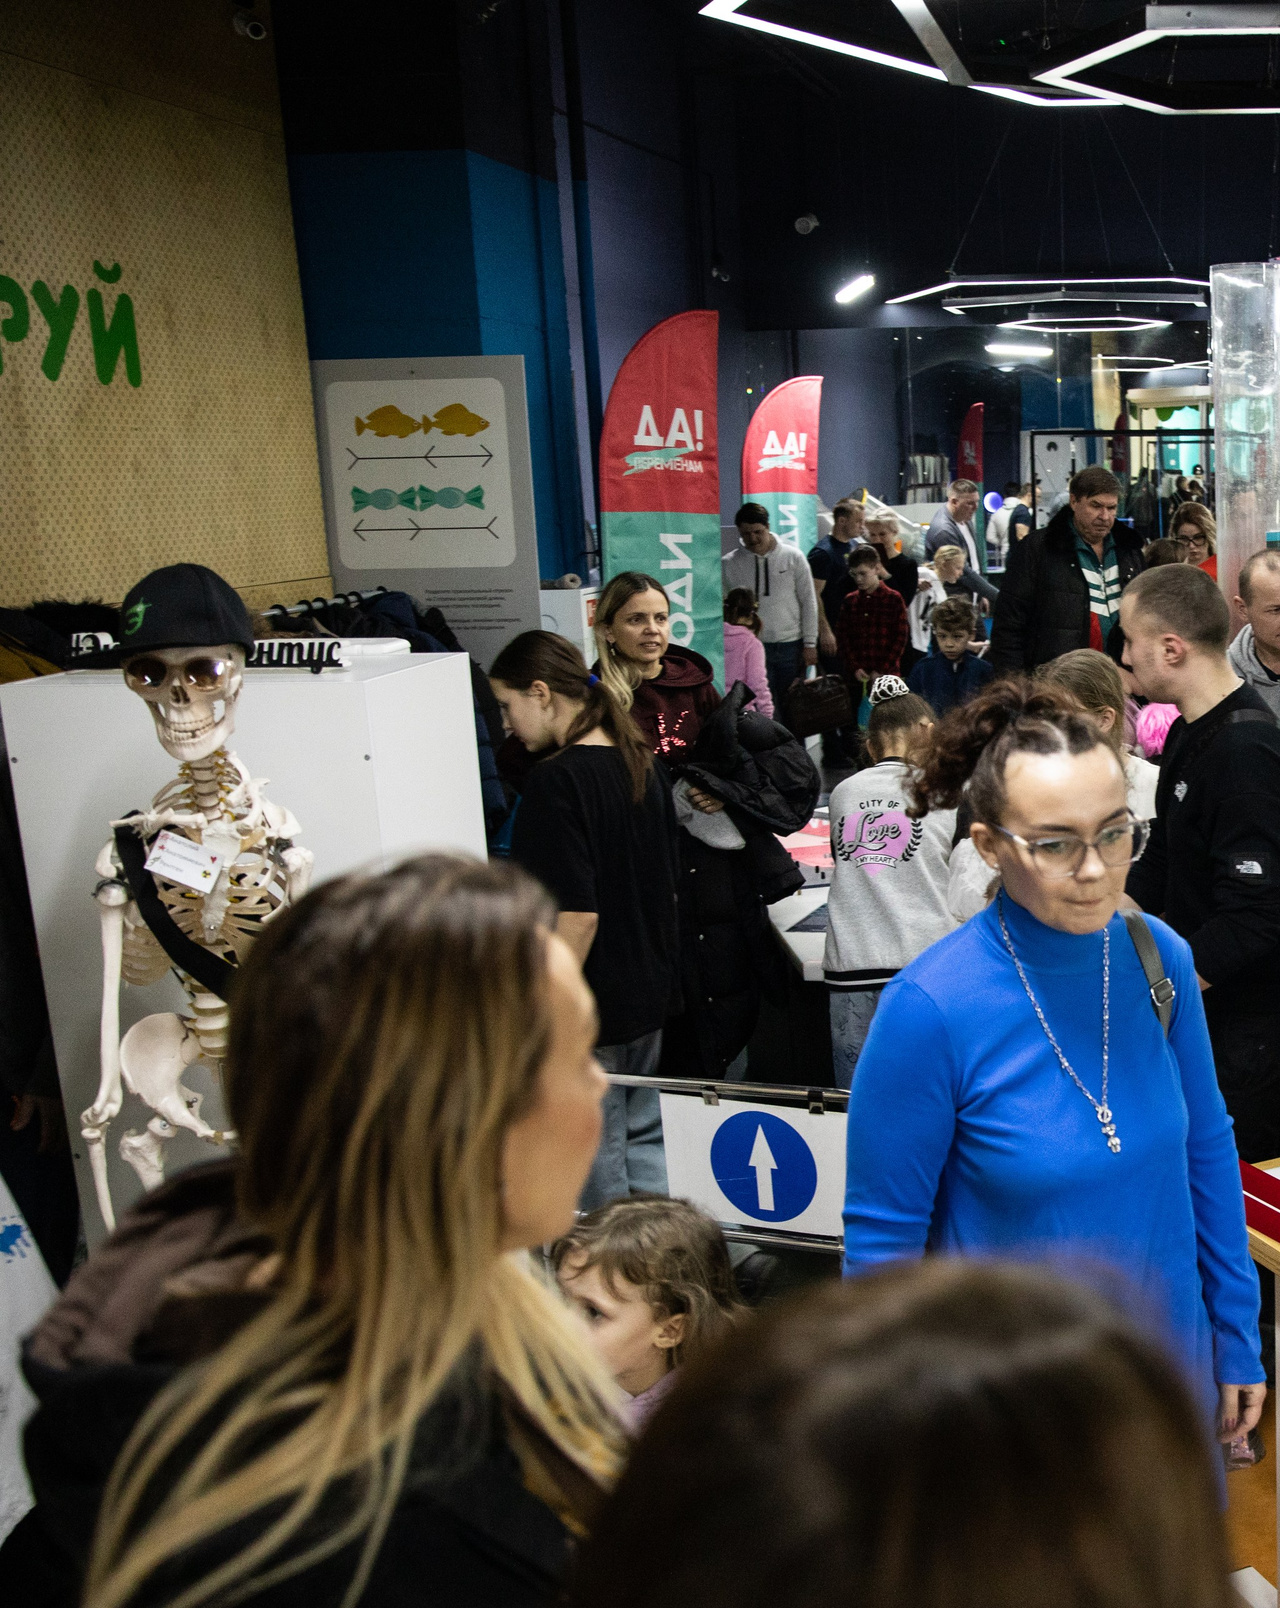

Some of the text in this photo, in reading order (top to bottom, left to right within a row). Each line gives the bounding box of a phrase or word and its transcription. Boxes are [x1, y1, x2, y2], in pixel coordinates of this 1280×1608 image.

[633, 404, 704, 452] ДА!
[762, 430, 807, 458] ДА!
[859, 799, 900, 810] CITY OF
[842, 810, 902, 853] Love
[859, 855, 893, 864] MY HEART
